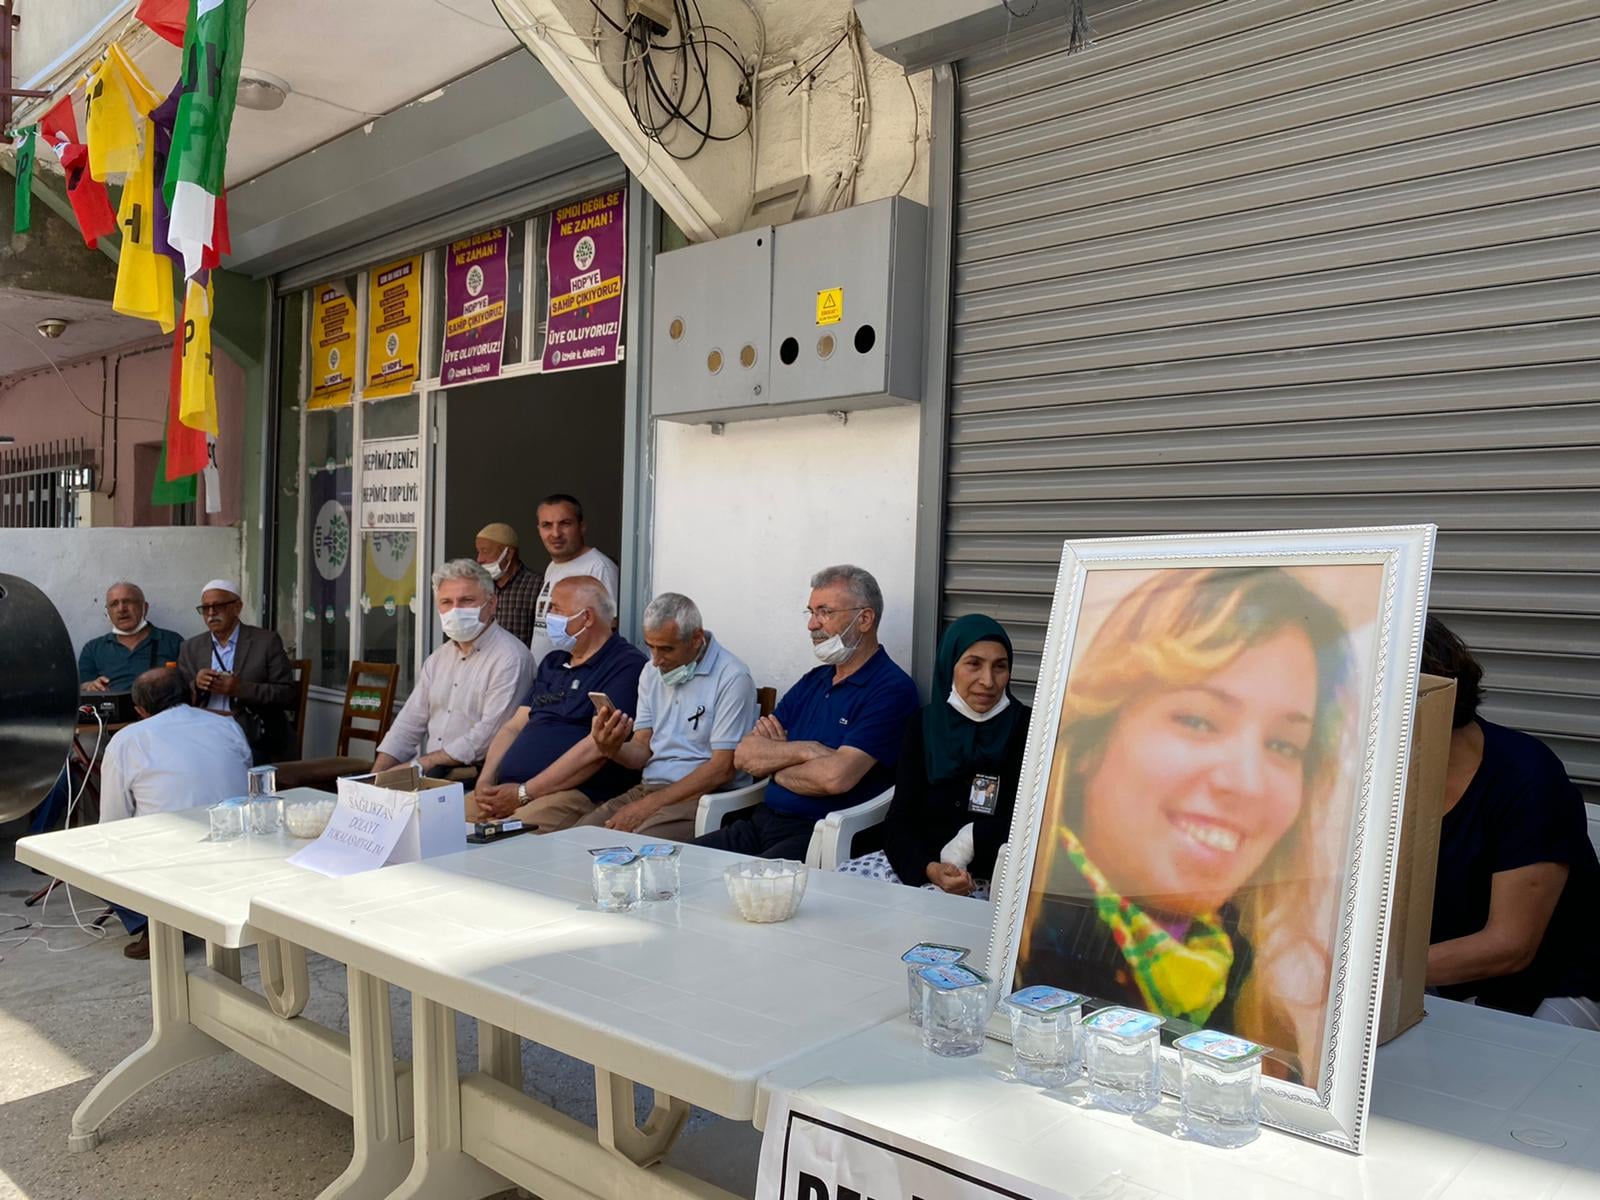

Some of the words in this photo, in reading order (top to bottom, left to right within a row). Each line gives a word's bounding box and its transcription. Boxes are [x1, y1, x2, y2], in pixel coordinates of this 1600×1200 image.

[560, 222, 574, 237] NE
[574, 212, 608, 233] ZAMAN
[455, 252, 466, 266] NE
[466, 244, 493, 263] ZAMAN
[572, 272, 600, 292] HDP'YE
[552, 294, 576, 313] SAHİP
[576, 281, 619, 306] ÇIKIYORUZ
[548, 330, 566, 345] ÜYE
[566, 321, 618, 342] OLUYORUZ!
[444, 349, 460, 364] ÜYE
[460, 341, 501, 360] OLUYORUZ!
